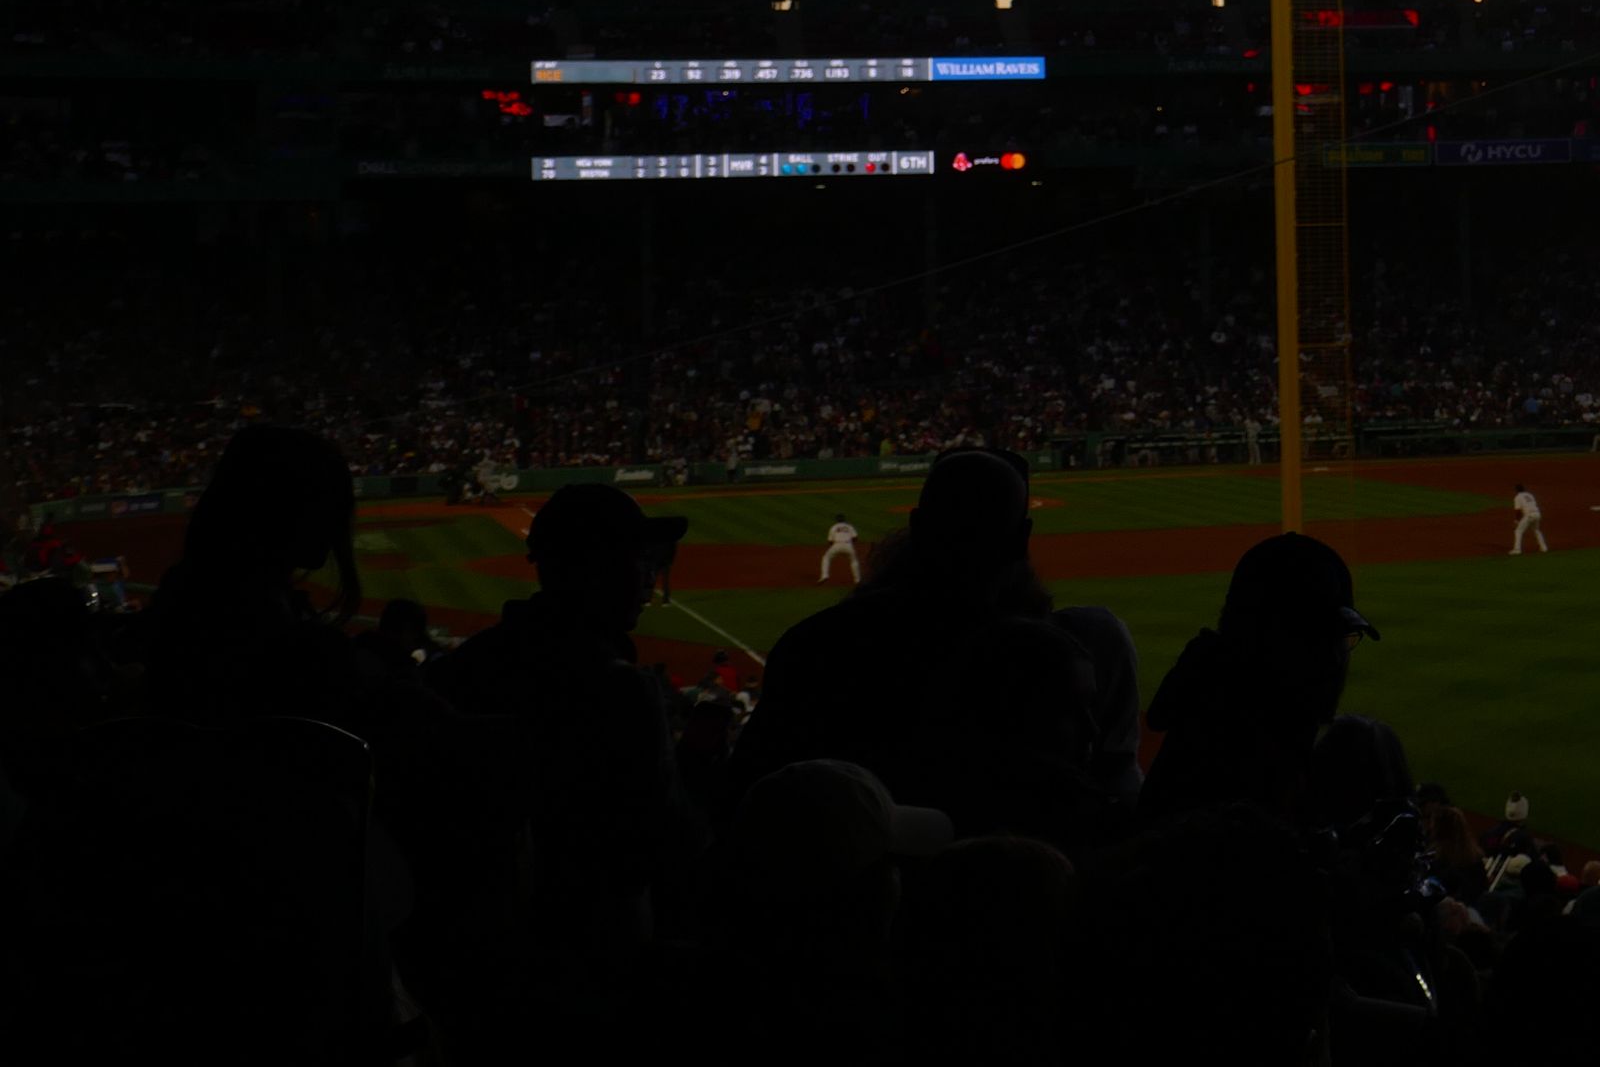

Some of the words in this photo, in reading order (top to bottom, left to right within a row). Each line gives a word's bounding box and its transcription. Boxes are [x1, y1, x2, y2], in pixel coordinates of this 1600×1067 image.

[936, 62, 995, 76] WILLIAM
[996, 61, 1040, 75] RAVEIS
[867, 152, 887, 162] OUT
[1487, 143, 1541, 160] HYCU
[788, 154, 814, 164] BALL
[827, 153, 859, 163] STRIKE
[900, 156, 927, 170] 6TH
